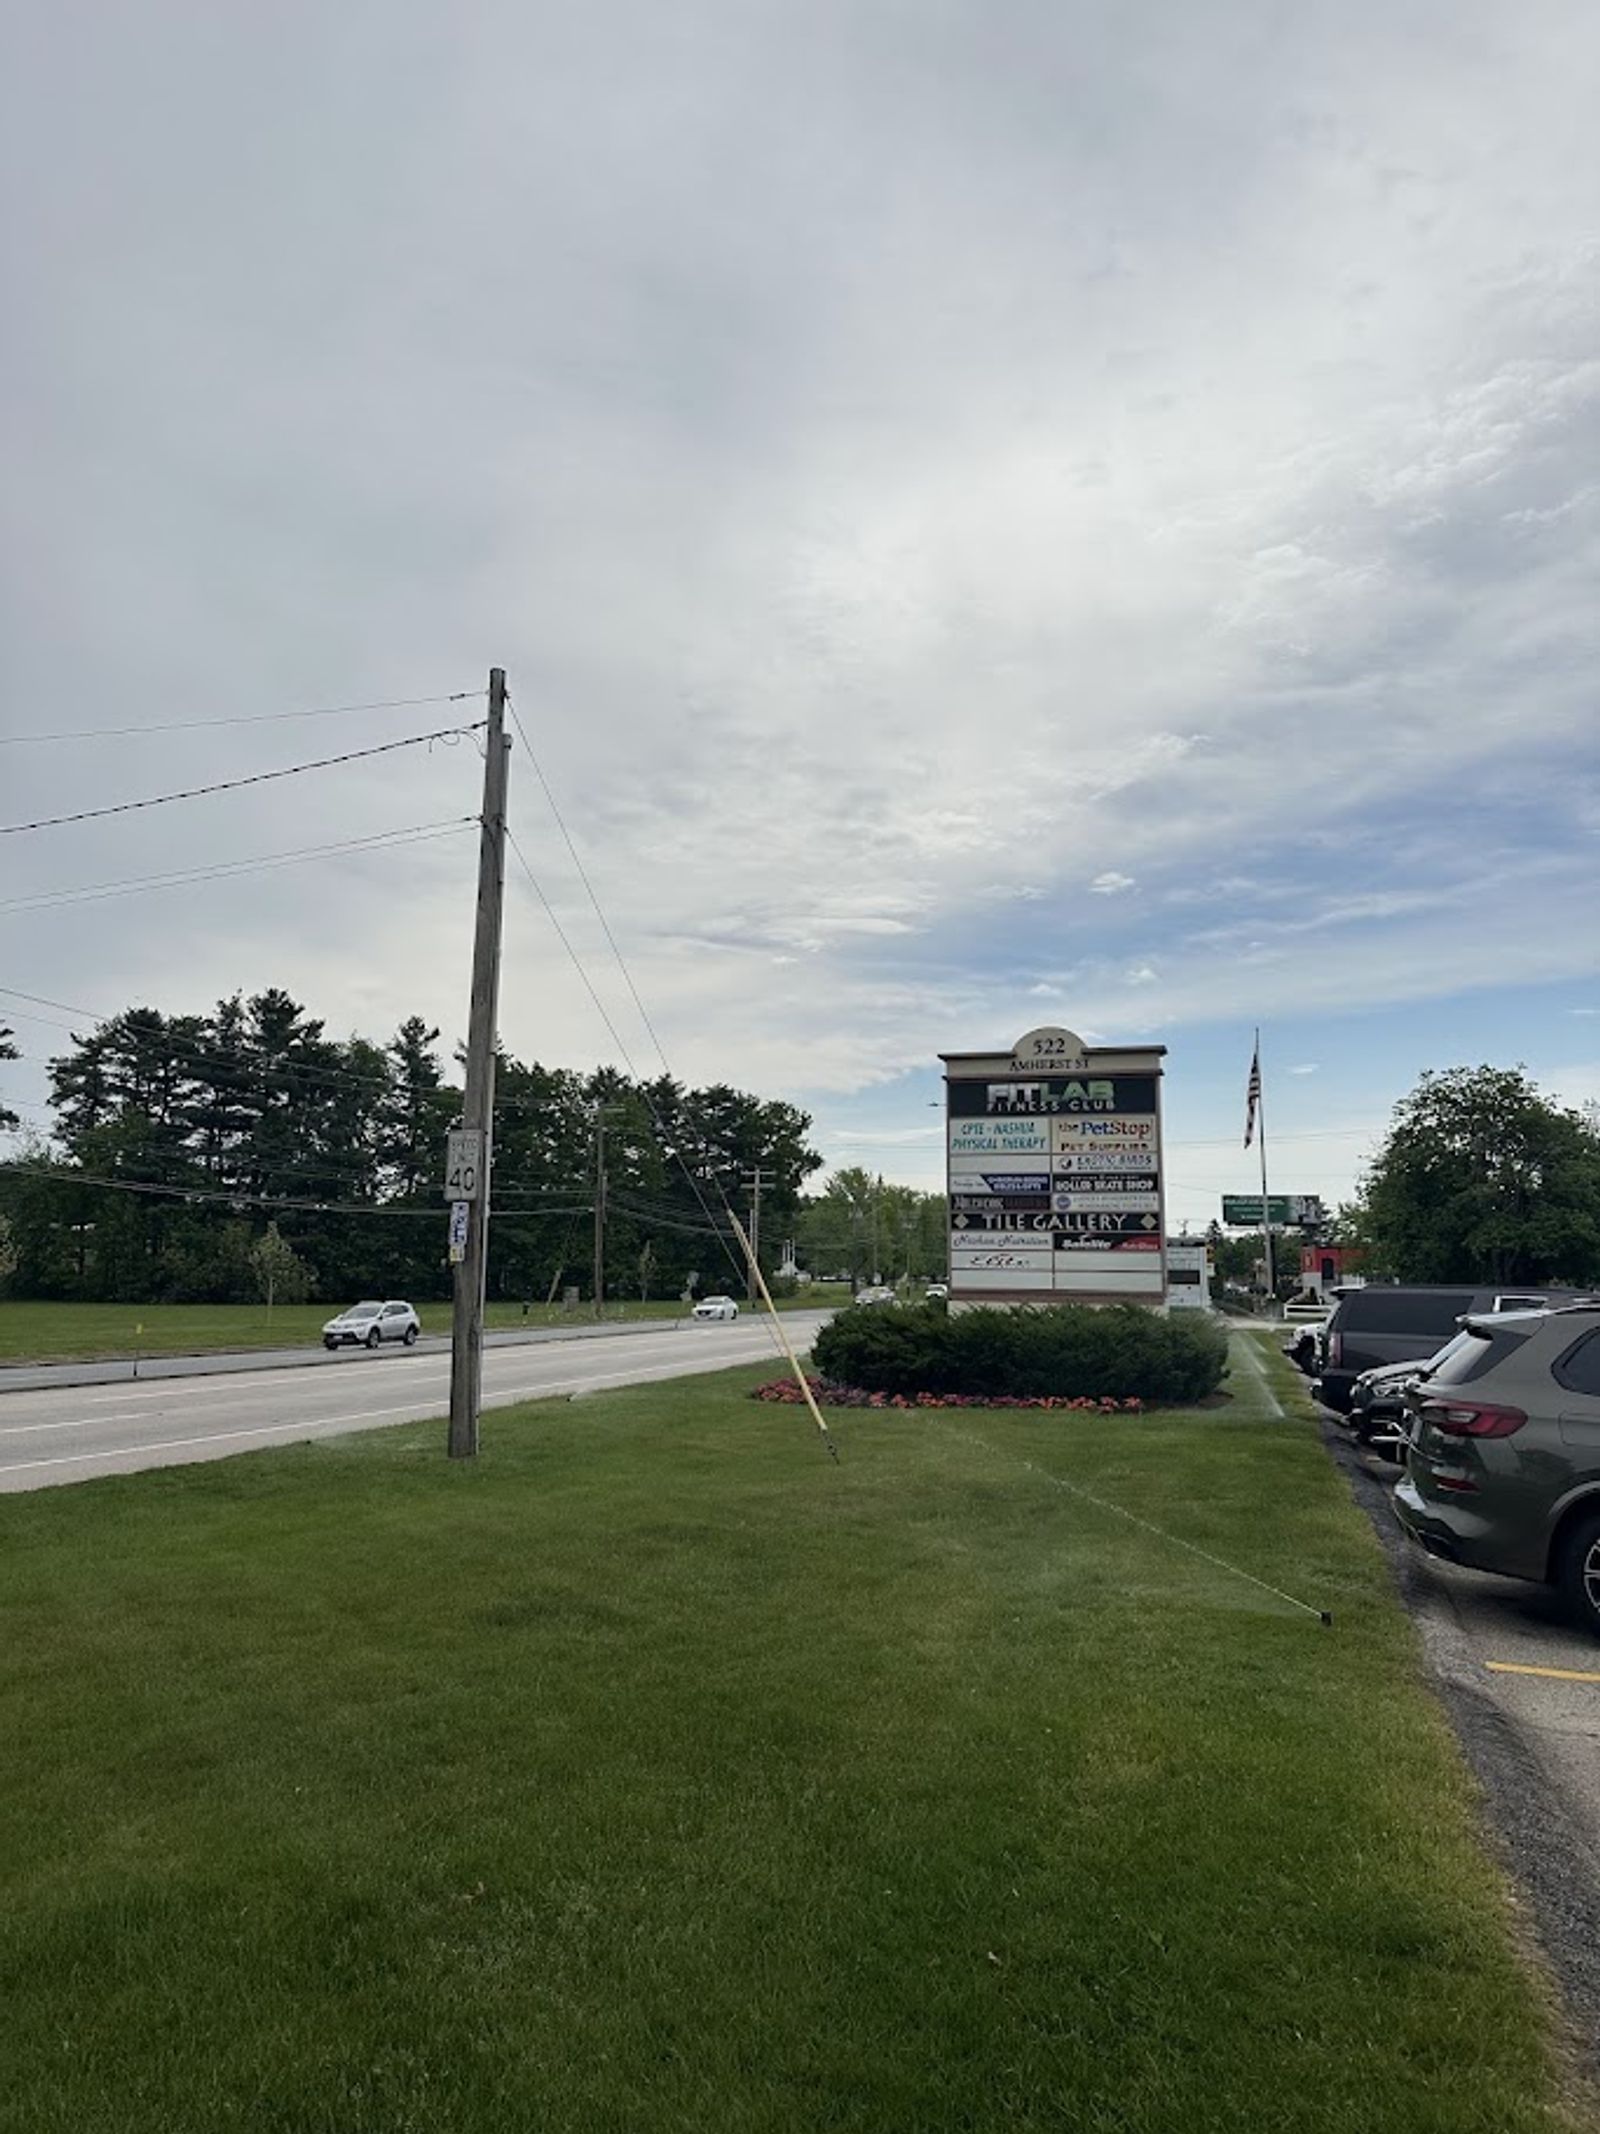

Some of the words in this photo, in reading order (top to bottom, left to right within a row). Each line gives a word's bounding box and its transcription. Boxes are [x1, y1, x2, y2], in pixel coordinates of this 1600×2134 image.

[1033, 1037, 1065, 1056] 522
[1009, 1059, 1071, 1072] AMHERST
[1075, 1058, 1089, 1069] ST
[987, 1081, 1114, 1102] FITLAB
[986, 1101, 1060, 1112] FITNESS
[1068, 1100, 1115, 1112] CLUB
[993, 1122, 1035, 1135] NASHUA
[1081, 1120, 1150, 1139] PetStop
[952, 1137, 998, 1150] PHYSICAL
[1001, 1136, 1047, 1149] THERAPY
[449, 1166, 475, 1192] 40
[1055, 1180, 1092, 1192] ROLLER
[1094, 1180, 1123, 1191] SKATE
[1126, 1180, 1154, 1191] SHOP
[982, 1213, 1026, 1230] TILE
[1033, 1213, 1128, 1231] GALLERY
